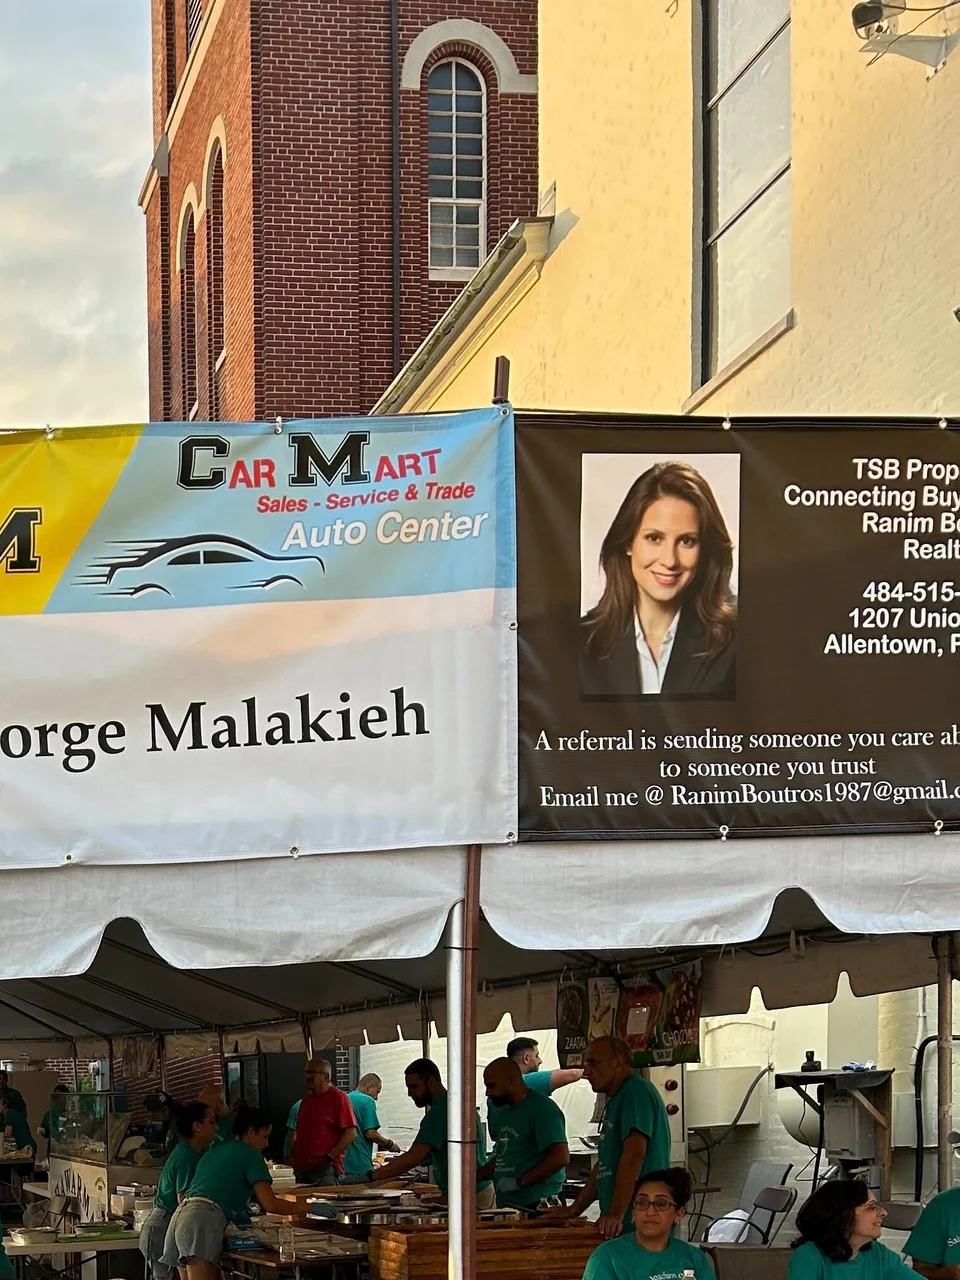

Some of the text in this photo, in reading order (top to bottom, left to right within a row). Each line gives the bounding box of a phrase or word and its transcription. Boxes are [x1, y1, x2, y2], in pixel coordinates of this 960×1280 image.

[176, 430, 442, 490] CAR MART
[852, 458, 900, 480] TSB
[256, 494, 308, 514] Sales
[326, 487, 399, 511] Service
[404, 485, 419, 502] &
[425, 482, 475, 501] Trade
[784, 484, 916, 511] Connecting
[281, 510, 489, 552] Auto Center
[862, 511, 960, 533] Ranim B
[862, 581, 960, 602] 484-515-
[848, 607, 904, 628] 1207
[823, 633, 943, 657] Allentown,
[145, 686, 430, 752] Malakieh
[535, 730, 552, 751] A
[558, 729, 634, 751] referral
[640, 730, 657, 750] is
[663, 728, 743, 754] sending
[749, 731, 841, 750] someone
[848, 732, 886, 751] you
[891, 731, 935, 746] care
[660, 757, 877, 780] to someone you trust
[539, 785, 600, 807] Email
[605, 790, 639, 806] me
[645, 785, 665, 806] @
